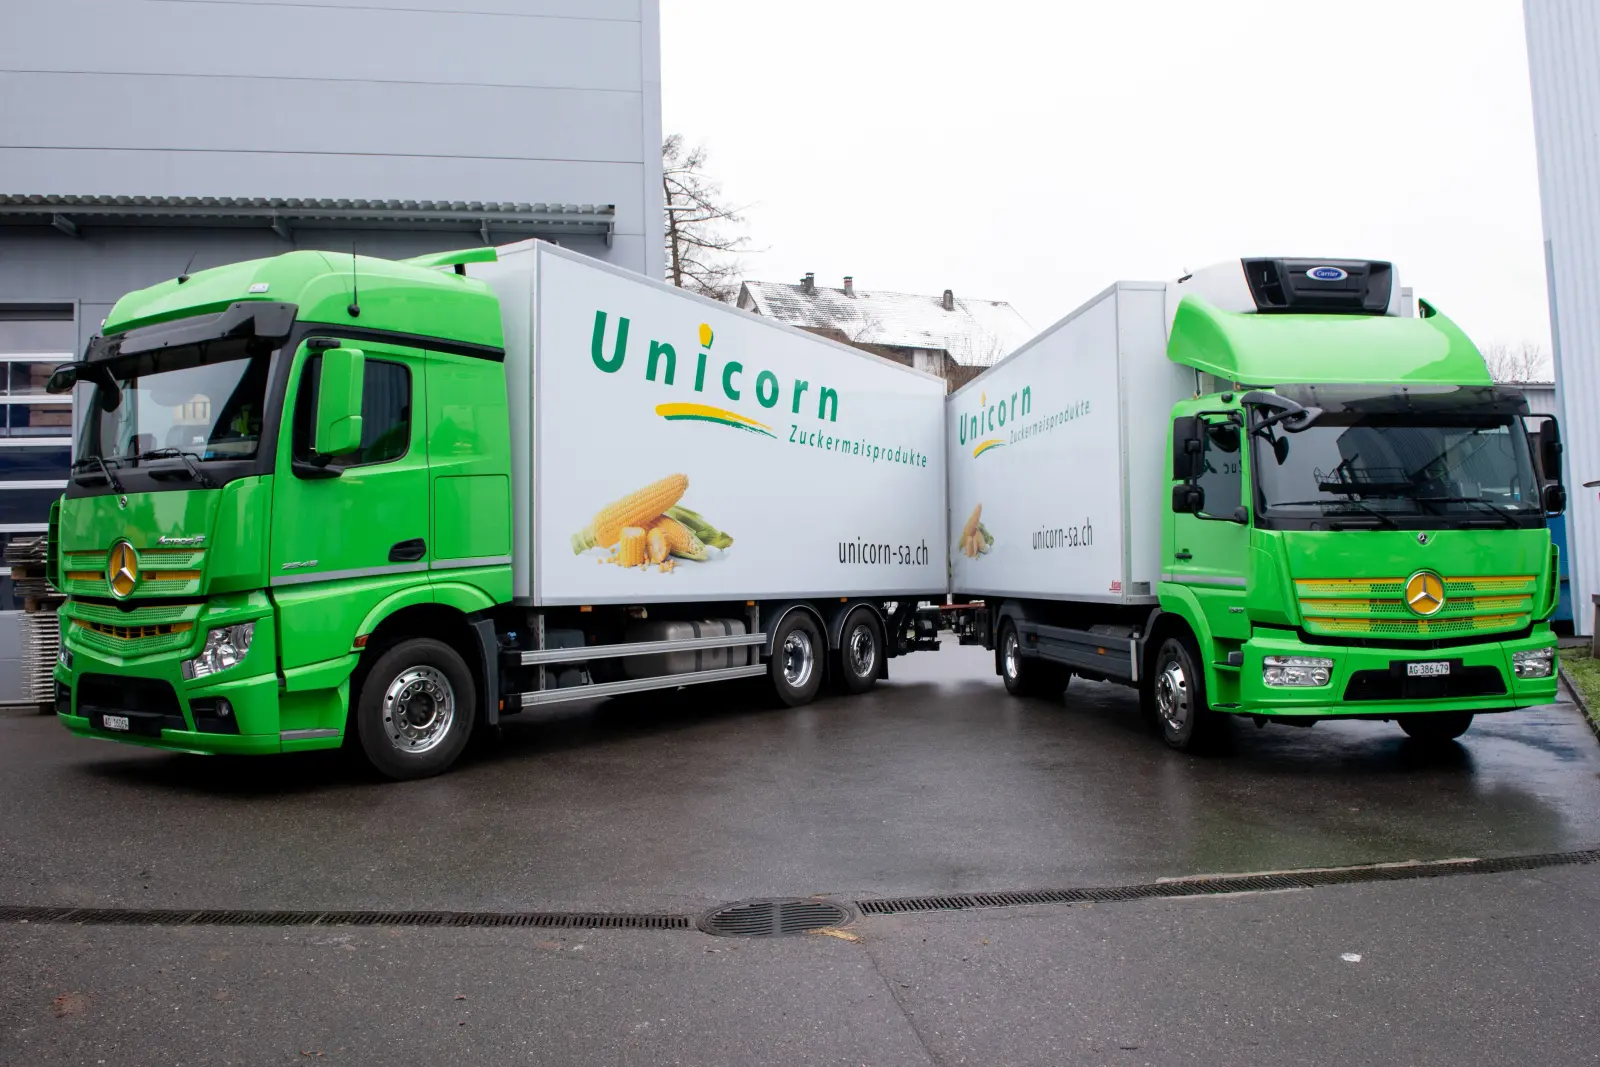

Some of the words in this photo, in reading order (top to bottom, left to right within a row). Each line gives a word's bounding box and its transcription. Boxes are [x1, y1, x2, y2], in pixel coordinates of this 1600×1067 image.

[591, 310, 838, 422] Unicorn
[960, 385, 1032, 446] Unicorn
[1010, 400, 1090, 445] Zuckermaisprodukte
[789, 424, 927, 468] Zuckermaisprodukte
[838, 536, 929, 566] unicorn-sa.ch
[1032, 516, 1093, 550] unicorn-sa.ch
